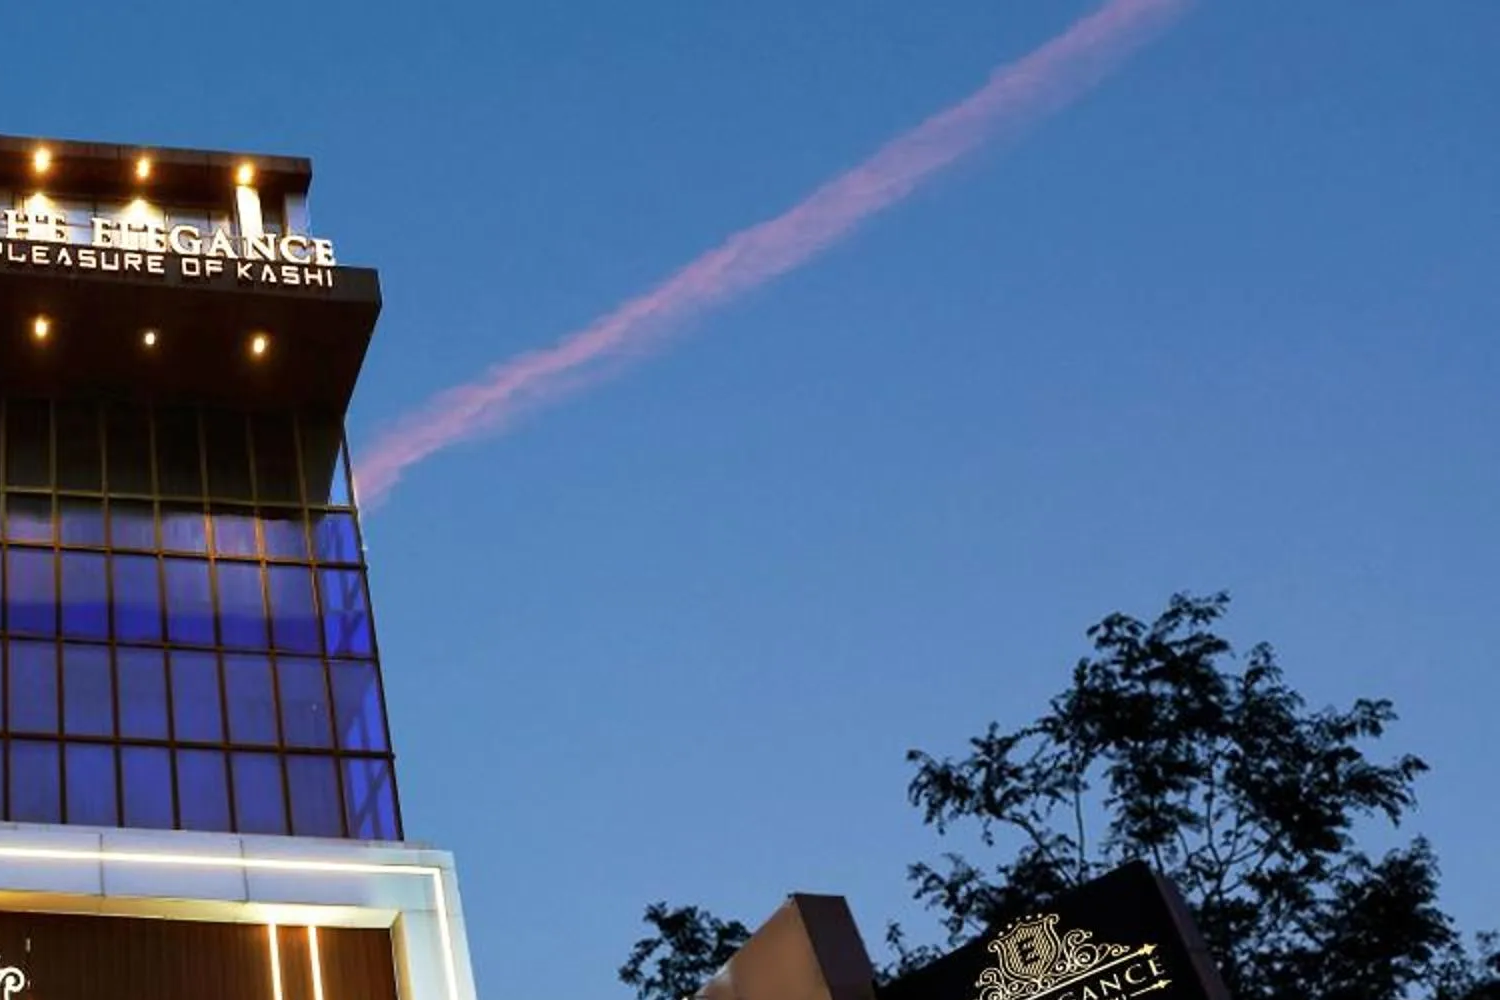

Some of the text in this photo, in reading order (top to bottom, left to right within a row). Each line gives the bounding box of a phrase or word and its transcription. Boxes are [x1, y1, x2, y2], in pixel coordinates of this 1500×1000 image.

[91, 216, 337, 267] ELEGANCE
[181, 257, 223, 277] OF
[237, 262, 334, 288] KASHI
